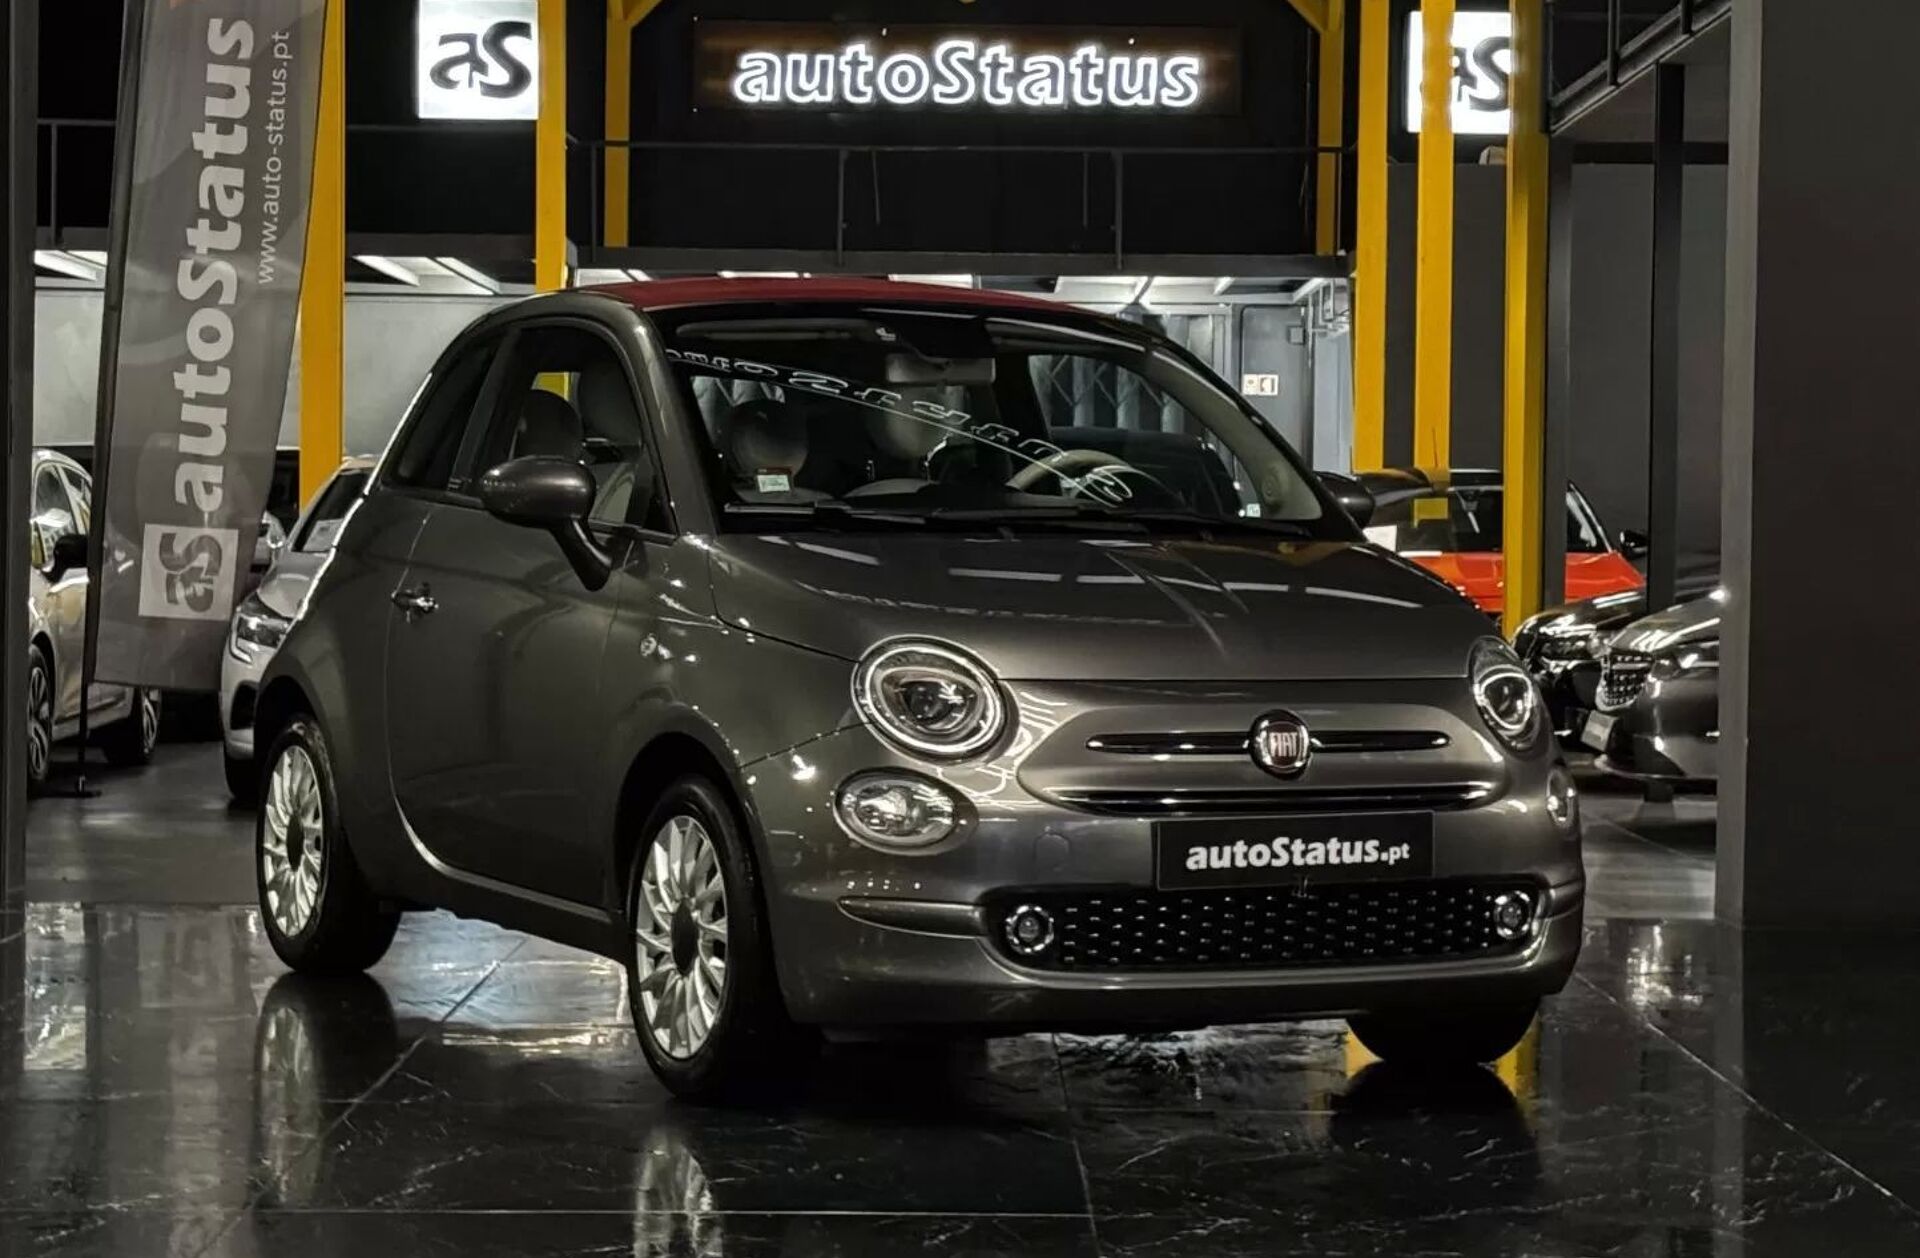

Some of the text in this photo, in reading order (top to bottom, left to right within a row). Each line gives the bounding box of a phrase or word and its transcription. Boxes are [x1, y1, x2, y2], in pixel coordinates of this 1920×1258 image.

[733, 40, 1200, 107] autoStatus
[258, 31, 293, 284] www.auto-status.pt
[173, 18, 254, 512] autoStatus
[1269, 732, 1297, 757] FIAT
[1186, 837, 1410, 870] autoStatus.pt
